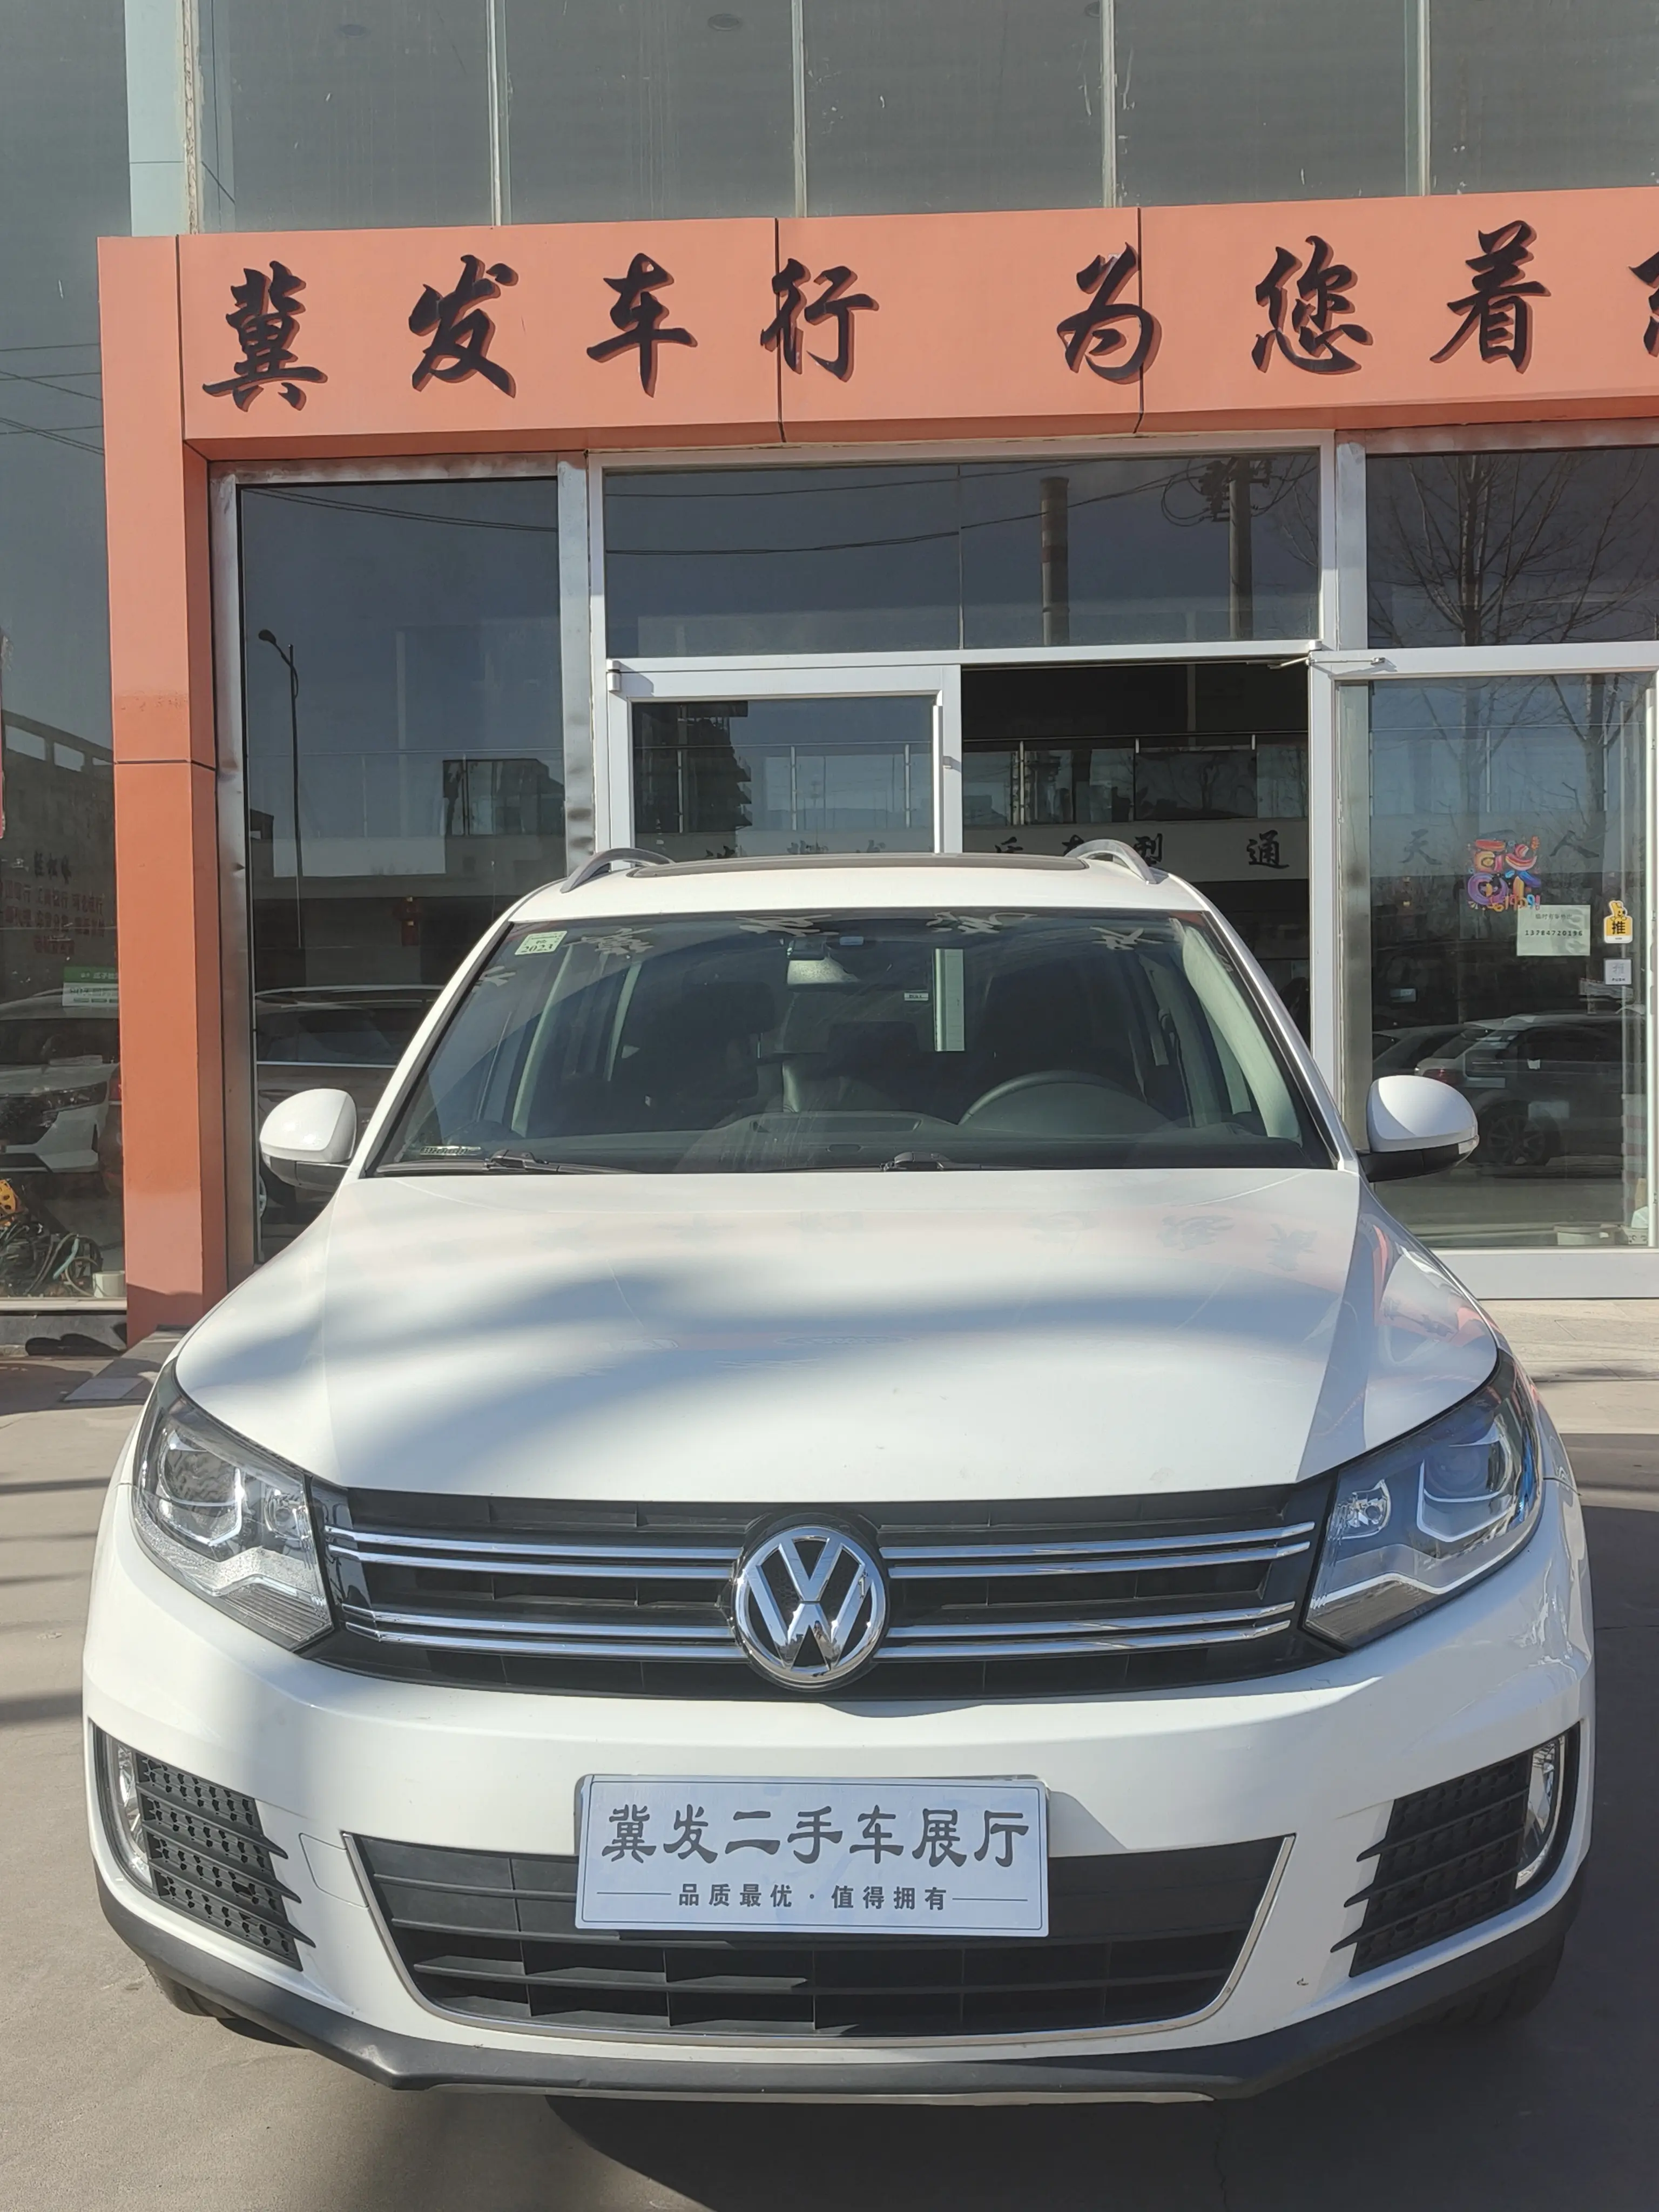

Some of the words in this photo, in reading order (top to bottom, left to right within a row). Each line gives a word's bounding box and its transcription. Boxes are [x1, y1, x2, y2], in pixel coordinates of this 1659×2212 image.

[202, 252, 880, 412] 冀发车行
[1612, 921, 1626, 934] 推
[601, 1803, 1029, 1867] 冀发二手车展厅
